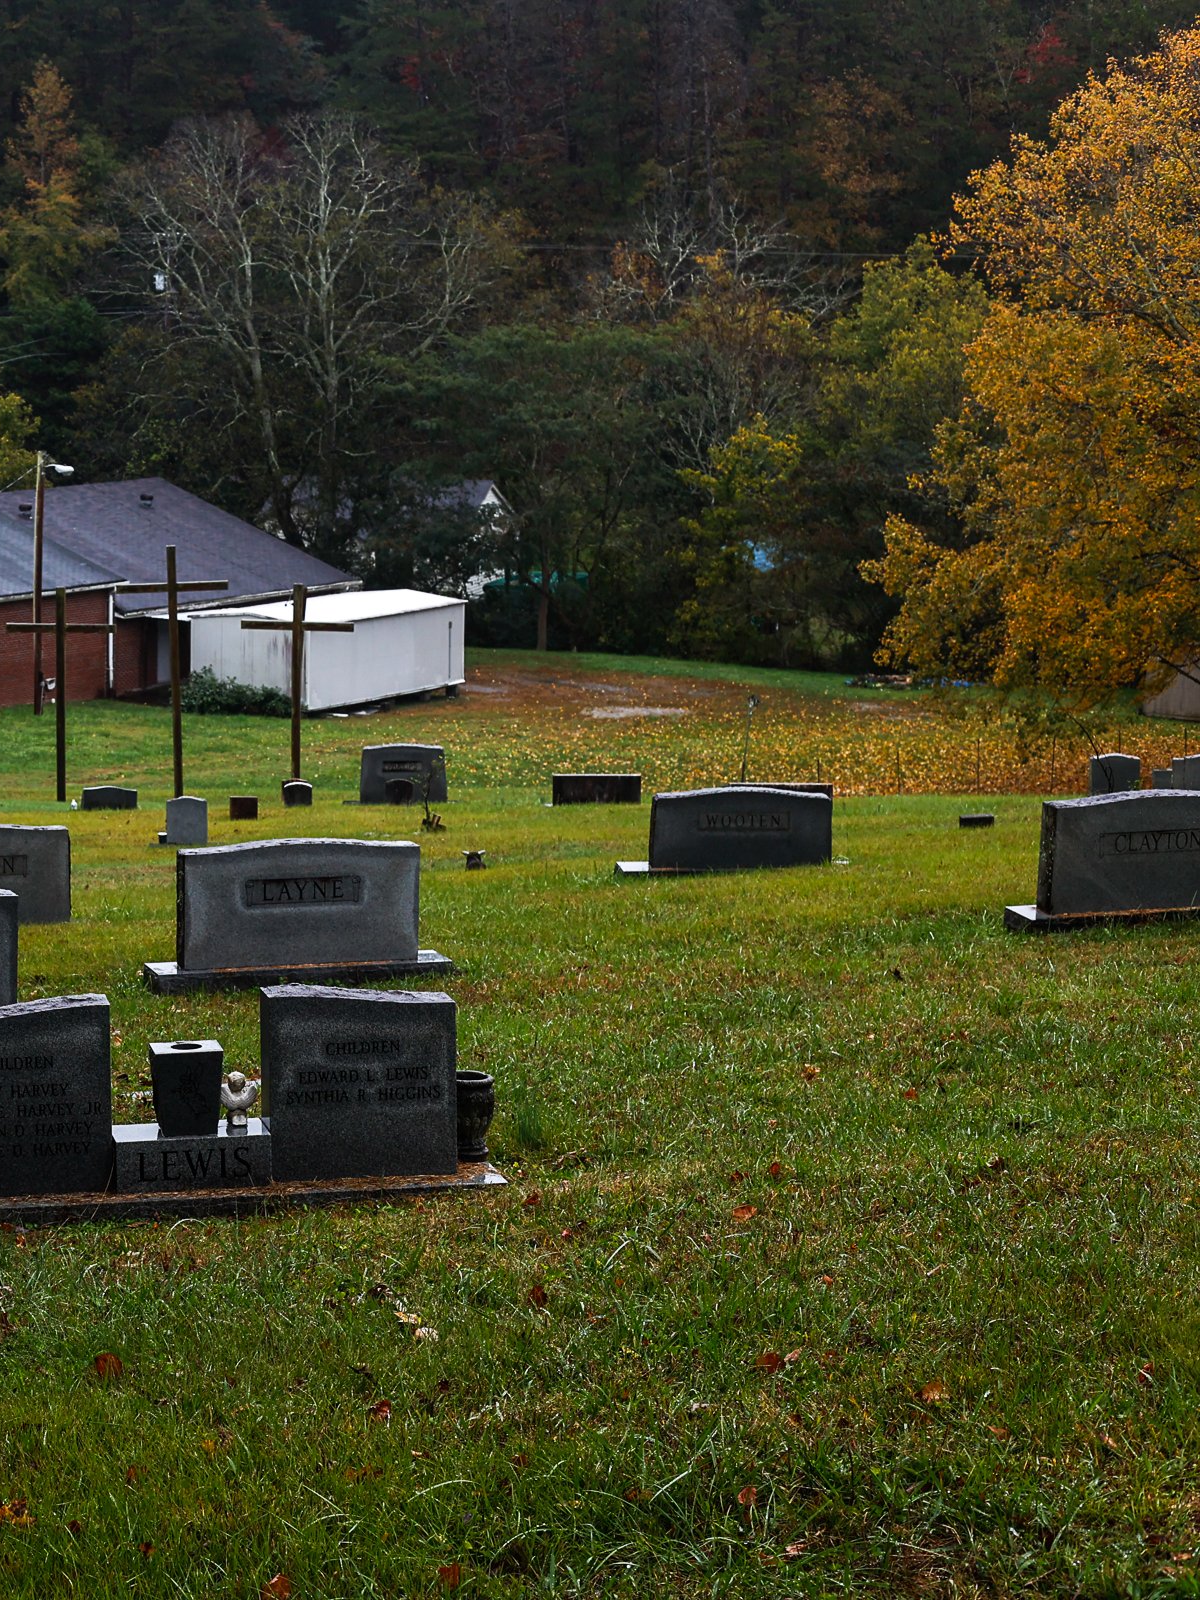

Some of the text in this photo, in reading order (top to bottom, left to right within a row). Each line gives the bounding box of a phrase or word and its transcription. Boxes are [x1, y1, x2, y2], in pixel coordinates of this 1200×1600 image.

[706, 814, 782, 829] WOOTEN
[262, 879, 345, 902] LAYNE
[326, 1040, 401, 1056] CHILDREN
[299, 1070, 359, 1085] EDWARD
[386, 1066, 430, 1081] LEWIS
[11, 1083, 70, 1098] HARVEY
[286, 1090, 349, 1105] SYNTHIA
[378, 1085, 442, 1101] HIGGINS
[17, 1102, 75, 1117] HARVEY
[35, 1121, 93, 1137] HARVEY
[33, 1141, 91, 1158] HARVEY
[137, 1146, 252, 1182] LEWIS
